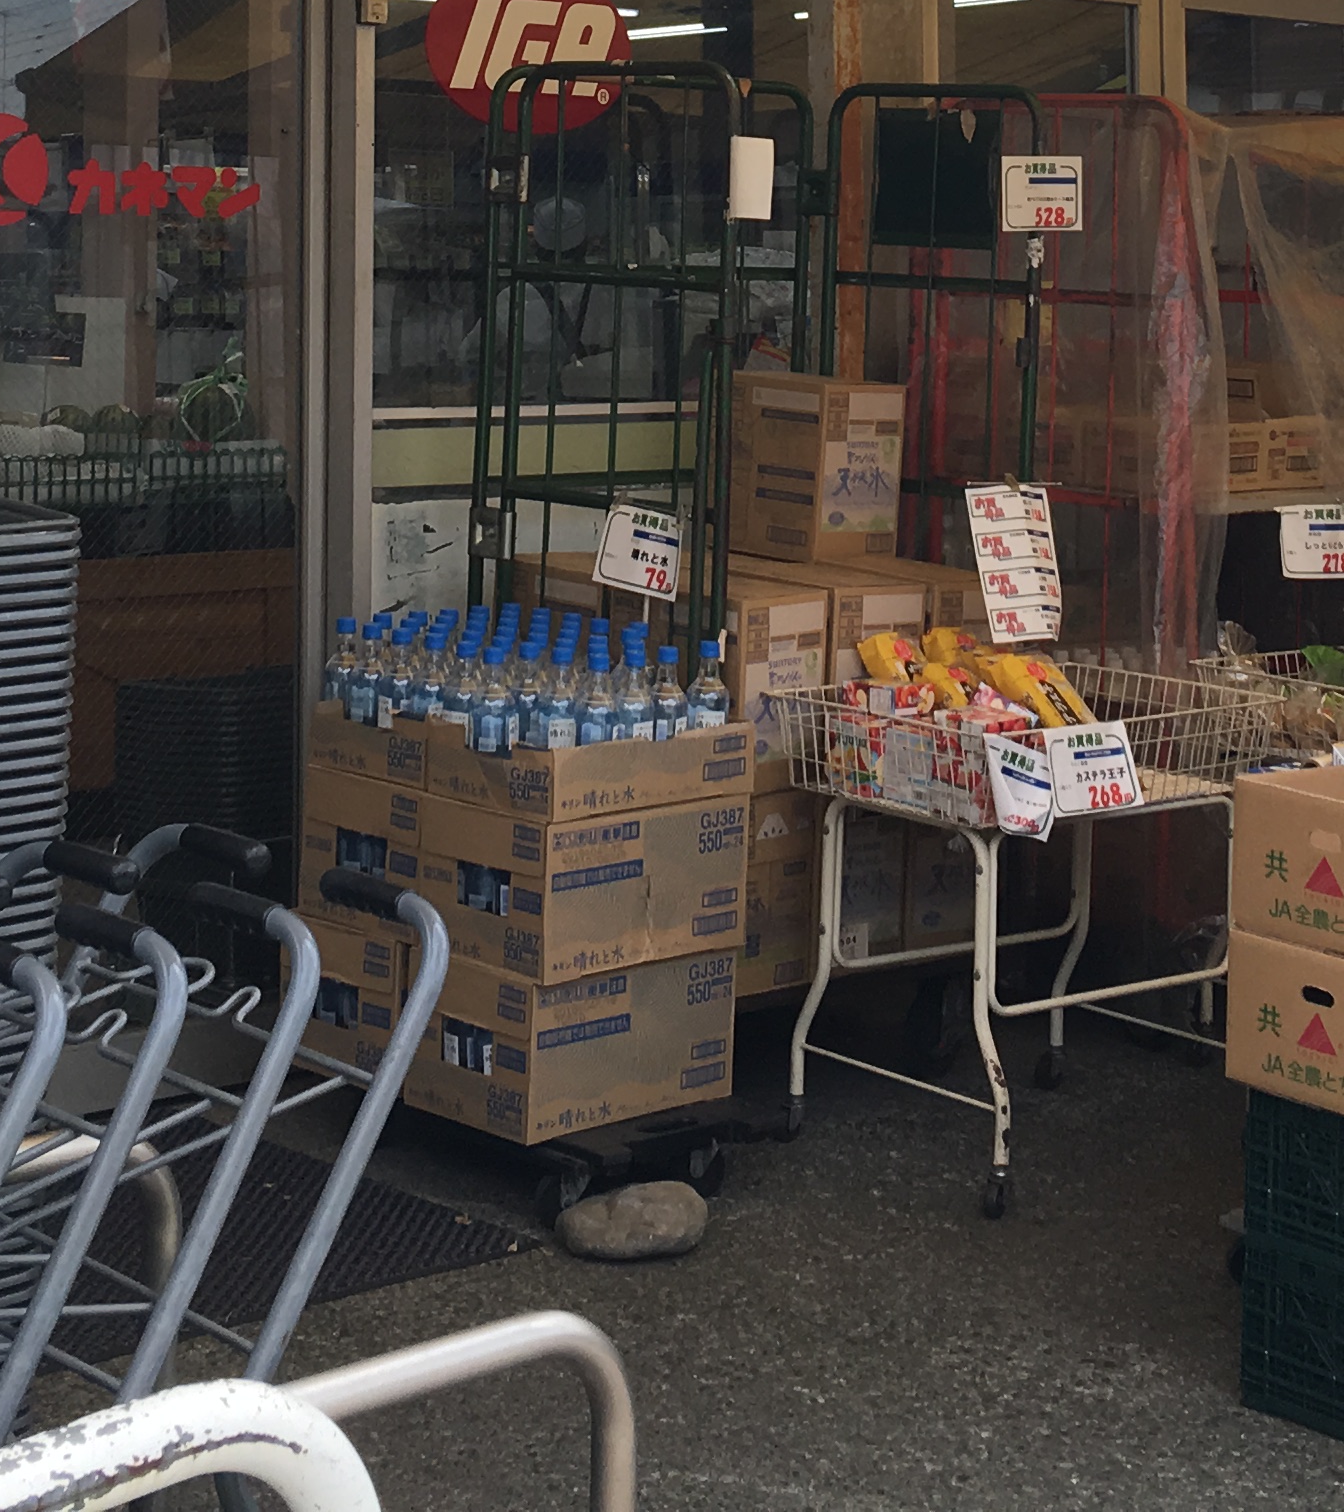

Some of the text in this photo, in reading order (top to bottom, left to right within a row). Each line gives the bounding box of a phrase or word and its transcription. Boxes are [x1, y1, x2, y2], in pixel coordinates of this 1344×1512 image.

[67, 158, 261, 219] カネマン
[630, 548, 670, 568] 晴れと水
[1068, 732, 1104, 749] お買得品
[1000, 748, 1036, 774] お買得品
[510, 765, 551, 786] GJ387
[1076, 766, 1127, 784] カステラ王子
[583, 785, 636, 810] 晴れと水
[700, 806, 746, 831] GJ387
[1264, 849, 1289, 883] 共
[573, 945, 626, 972] 晴れと水
[689, 957, 734, 982] GJ387
[1257, 1003, 1282, 1038] 共
[558, 1100, 612, 1129] 晴れと水
